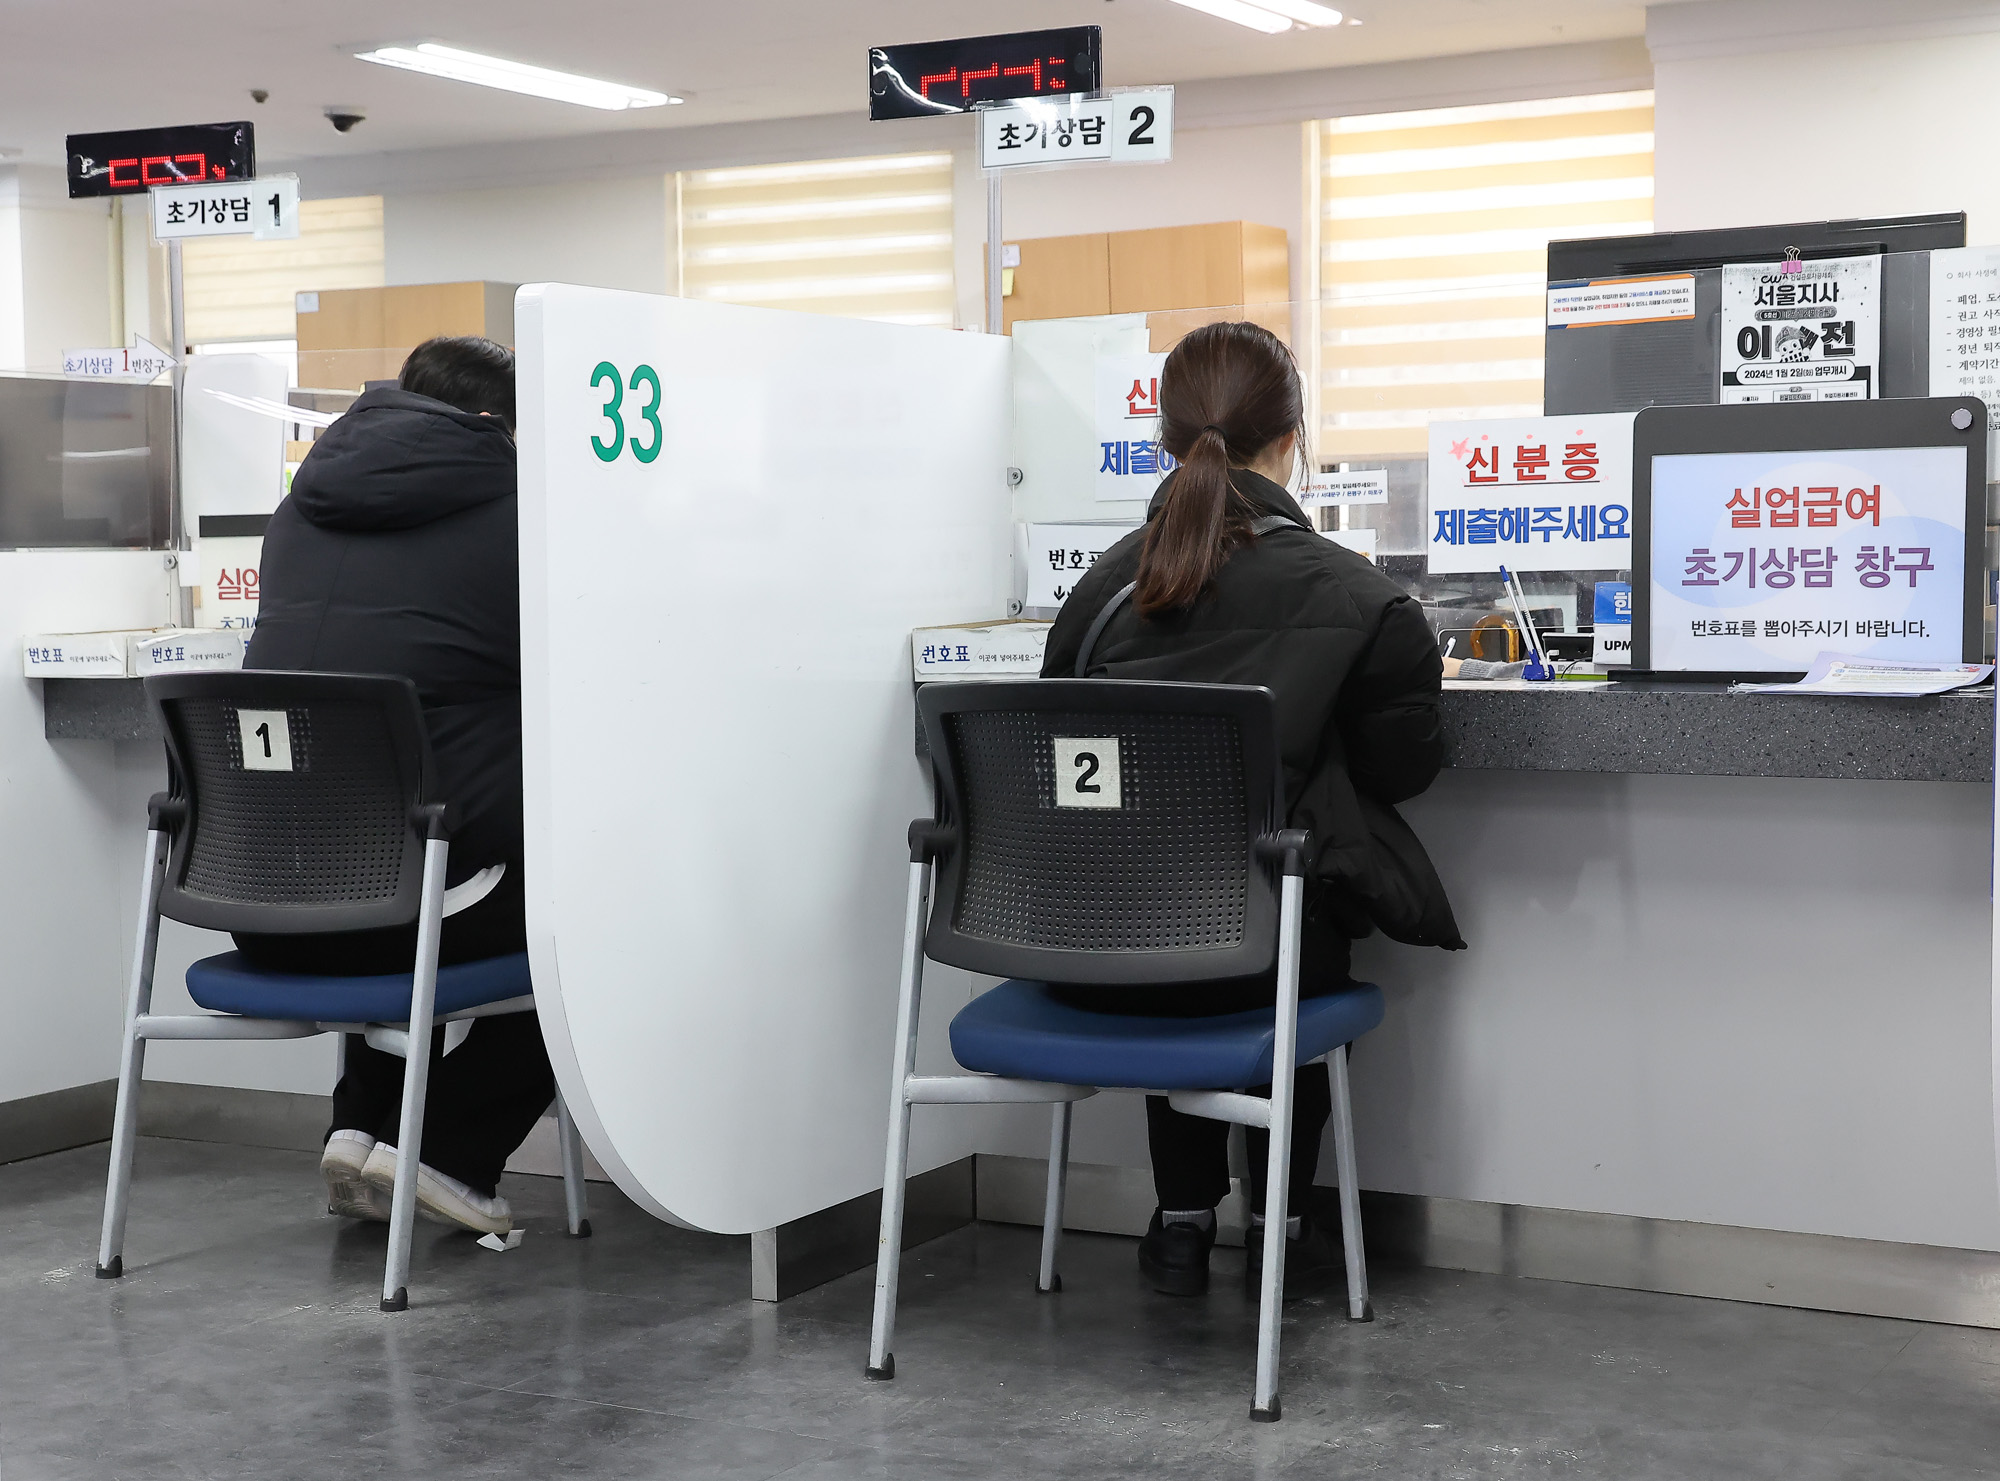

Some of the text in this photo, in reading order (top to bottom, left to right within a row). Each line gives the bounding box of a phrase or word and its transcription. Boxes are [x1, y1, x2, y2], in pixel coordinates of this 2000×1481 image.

[998, 105, 1155, 150] 초기상담 2
[166, 193, 280, 226] 초기상담 1
[1754, 282, 1840, 306] 서울지사
[1986, 293, 2000, 302] 도
[1957, 311, 1978, 321] 권고
[1820, 321, 1855, 357] 전
[1956, 326, 1984, 338] 경영상
[1957, 343, 1978, 354] 정년
[64, 357, 113, 375] 초기상담
[1744, 367, 1773, 379] 2024년
[1775, 368, 1788, 379] 1월
[1815, 365, 1847, 377] 업무개시
[1958, 358, 1999, 370] 계약기간
[590, 361, 662, 463] 33
[1725, 485, 1880, 528] 실업급여
[1433, 504, 1630, 545] 제출해주세요
[1682, 546, 1934, 589] 초기상담 창구
[1691, 619, 1930, 637] 번호표를 뽑아주시기 바랍니다.
[29, 648, 64, 663] 번호표
[152, 647, 185, 663] 번호표
[922, 645, 970, 663] 번호표
[979, 654, 997, 662] 이곳에
[255, 723, 271, 757] 1
[1074, 752, 1100, 793] 2
